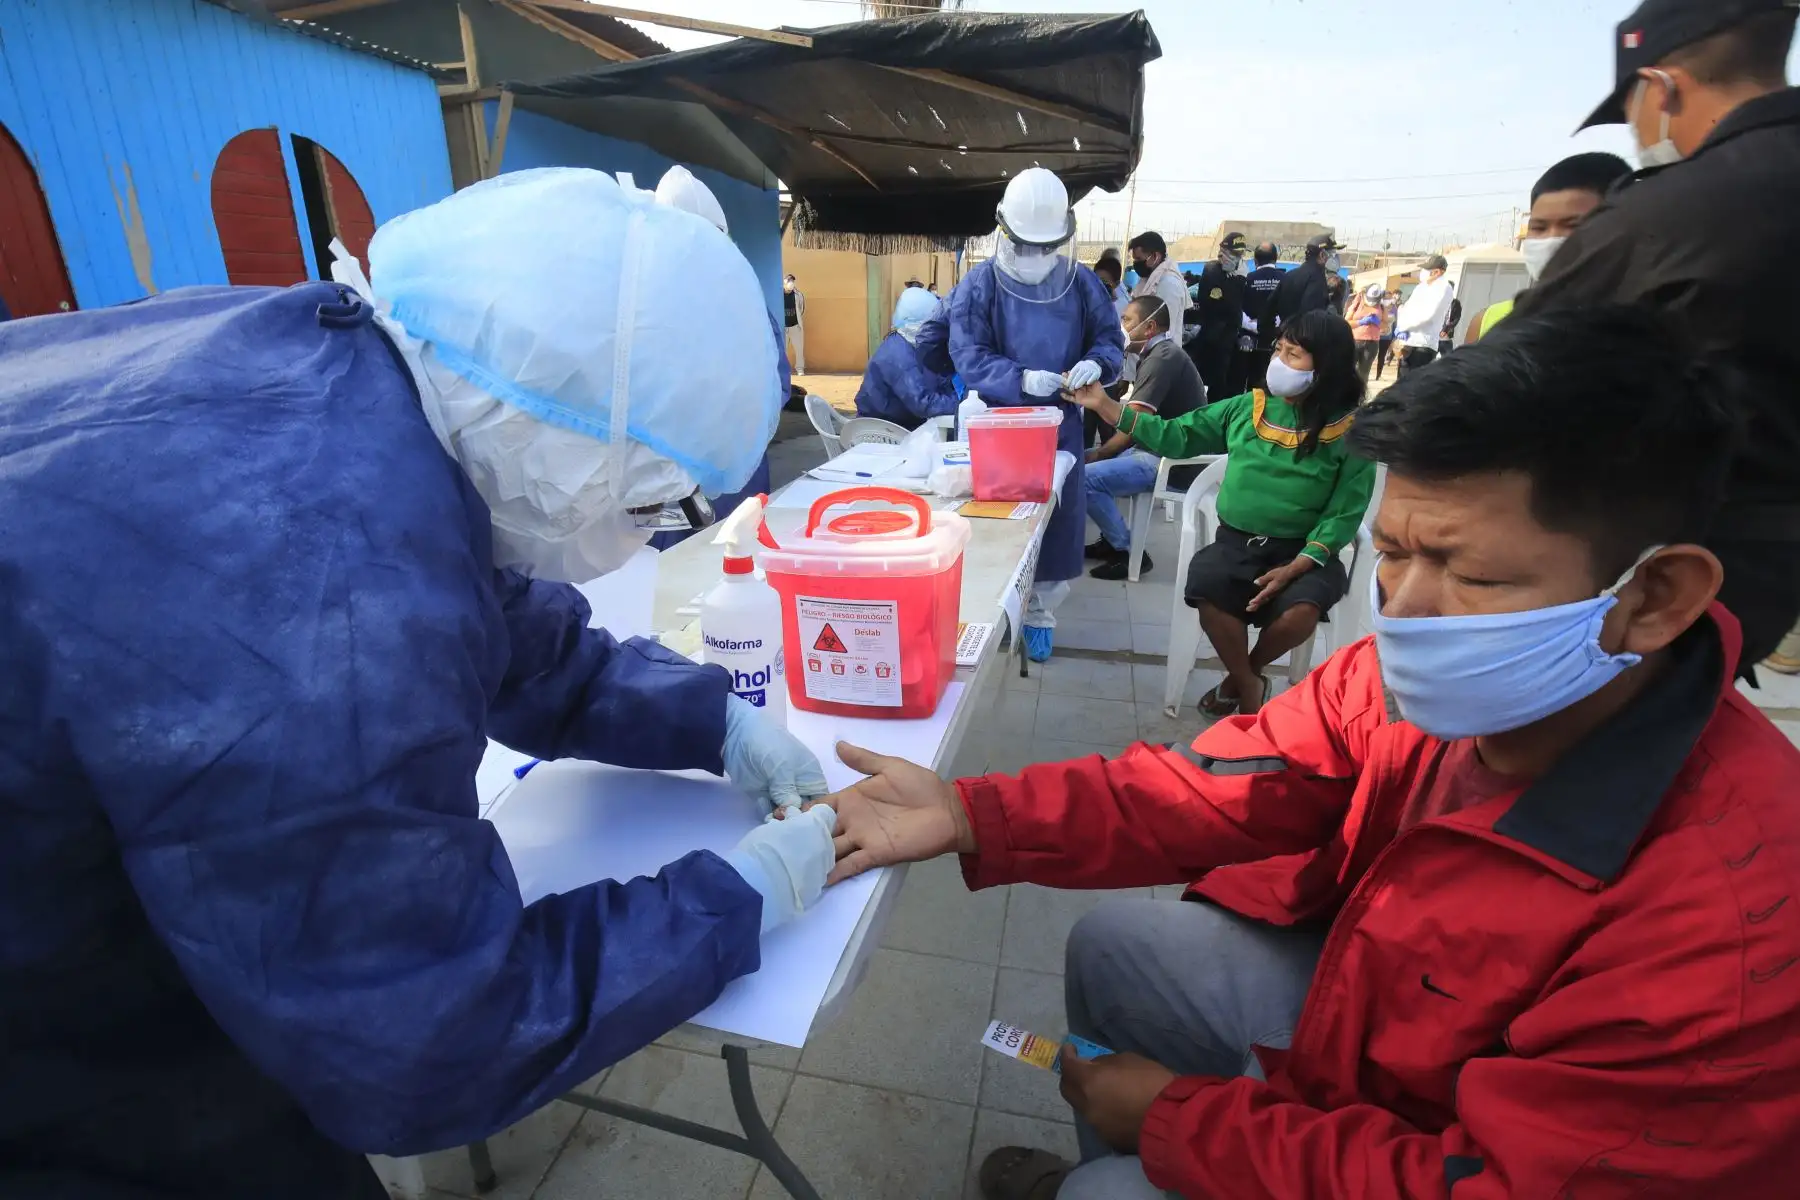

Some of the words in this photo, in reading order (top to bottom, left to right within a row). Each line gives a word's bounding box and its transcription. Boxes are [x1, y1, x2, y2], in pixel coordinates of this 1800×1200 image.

[801, 608, 826, 617] PELIGRO
[856, 612, 892, 621] BIOLÓGICO
[854, 628, 881, 637] Deslab
[705, 634, 762, 650] Alkofarma
[731, 664, 771, 689] hol
